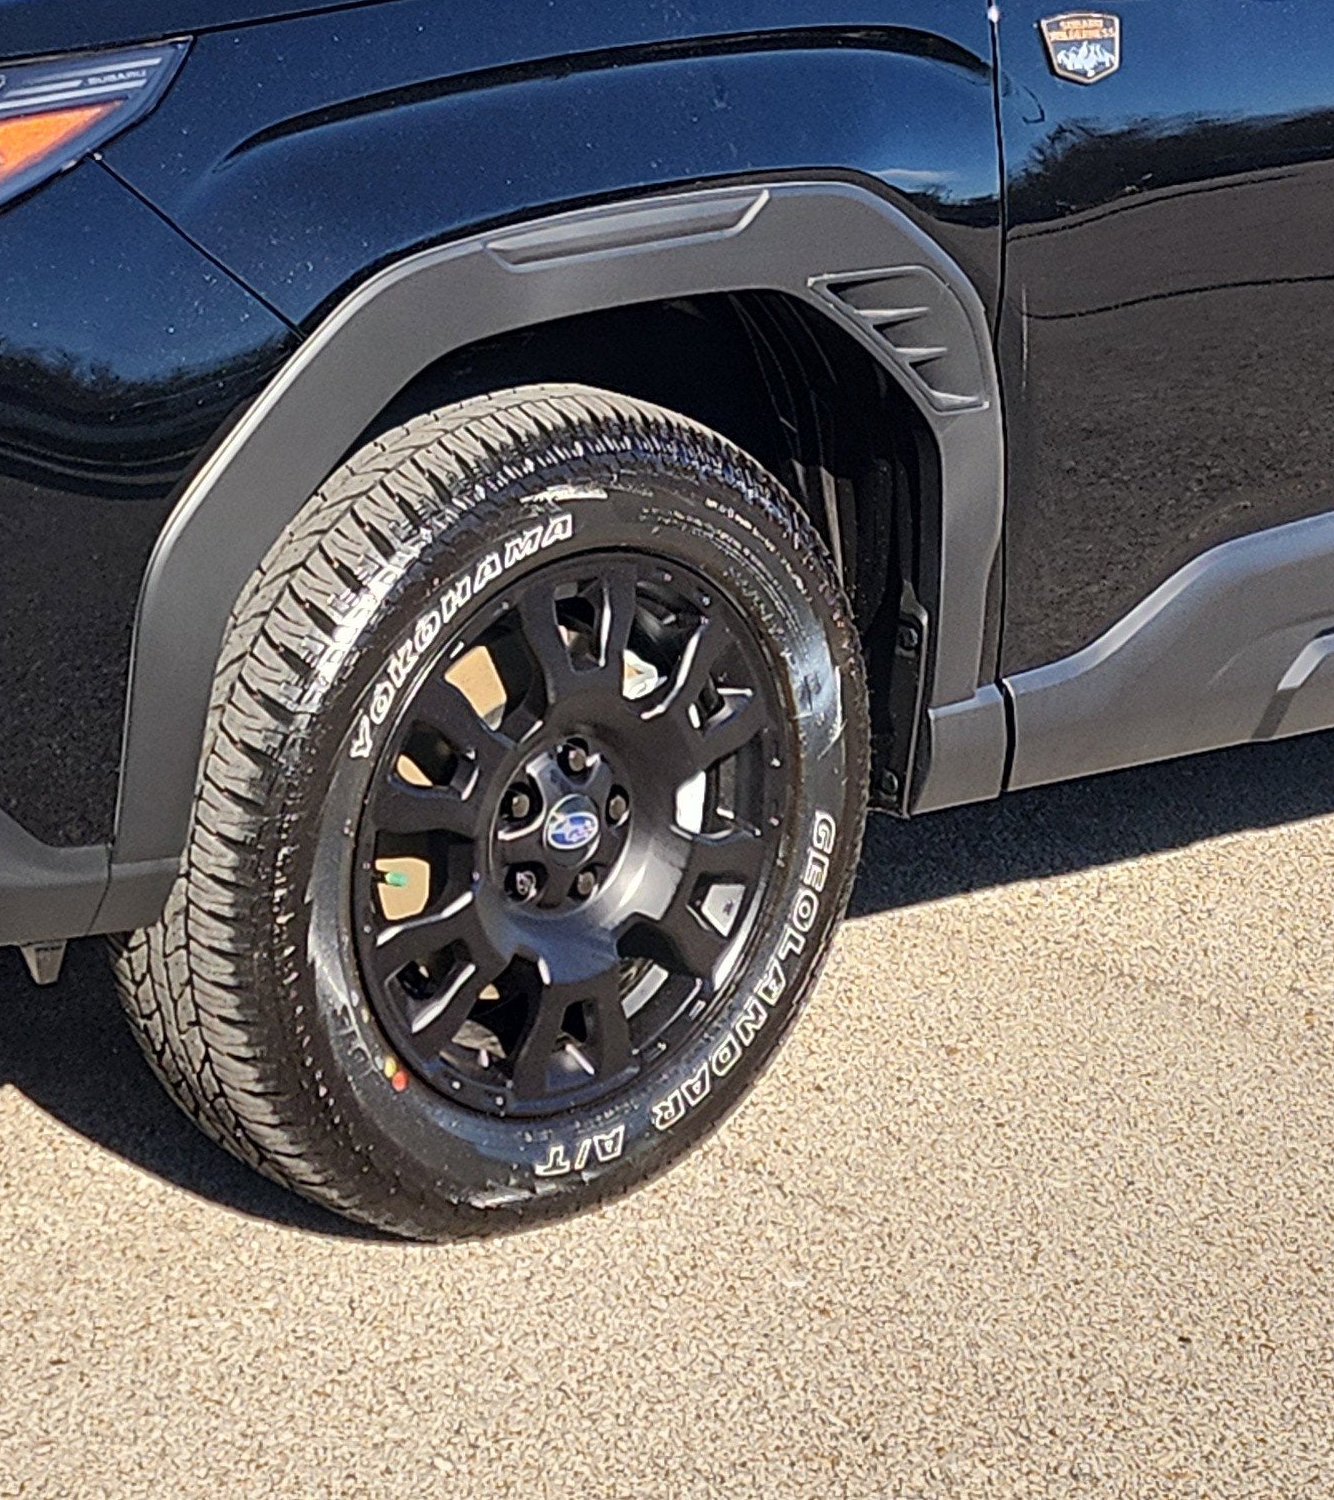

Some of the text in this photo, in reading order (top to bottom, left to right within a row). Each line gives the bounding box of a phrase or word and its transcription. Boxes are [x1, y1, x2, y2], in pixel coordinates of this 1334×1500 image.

[350, 513, 573, 758] YOKOHAMA
[534, 810, 837, 1177] GEOLANDAR A/T
